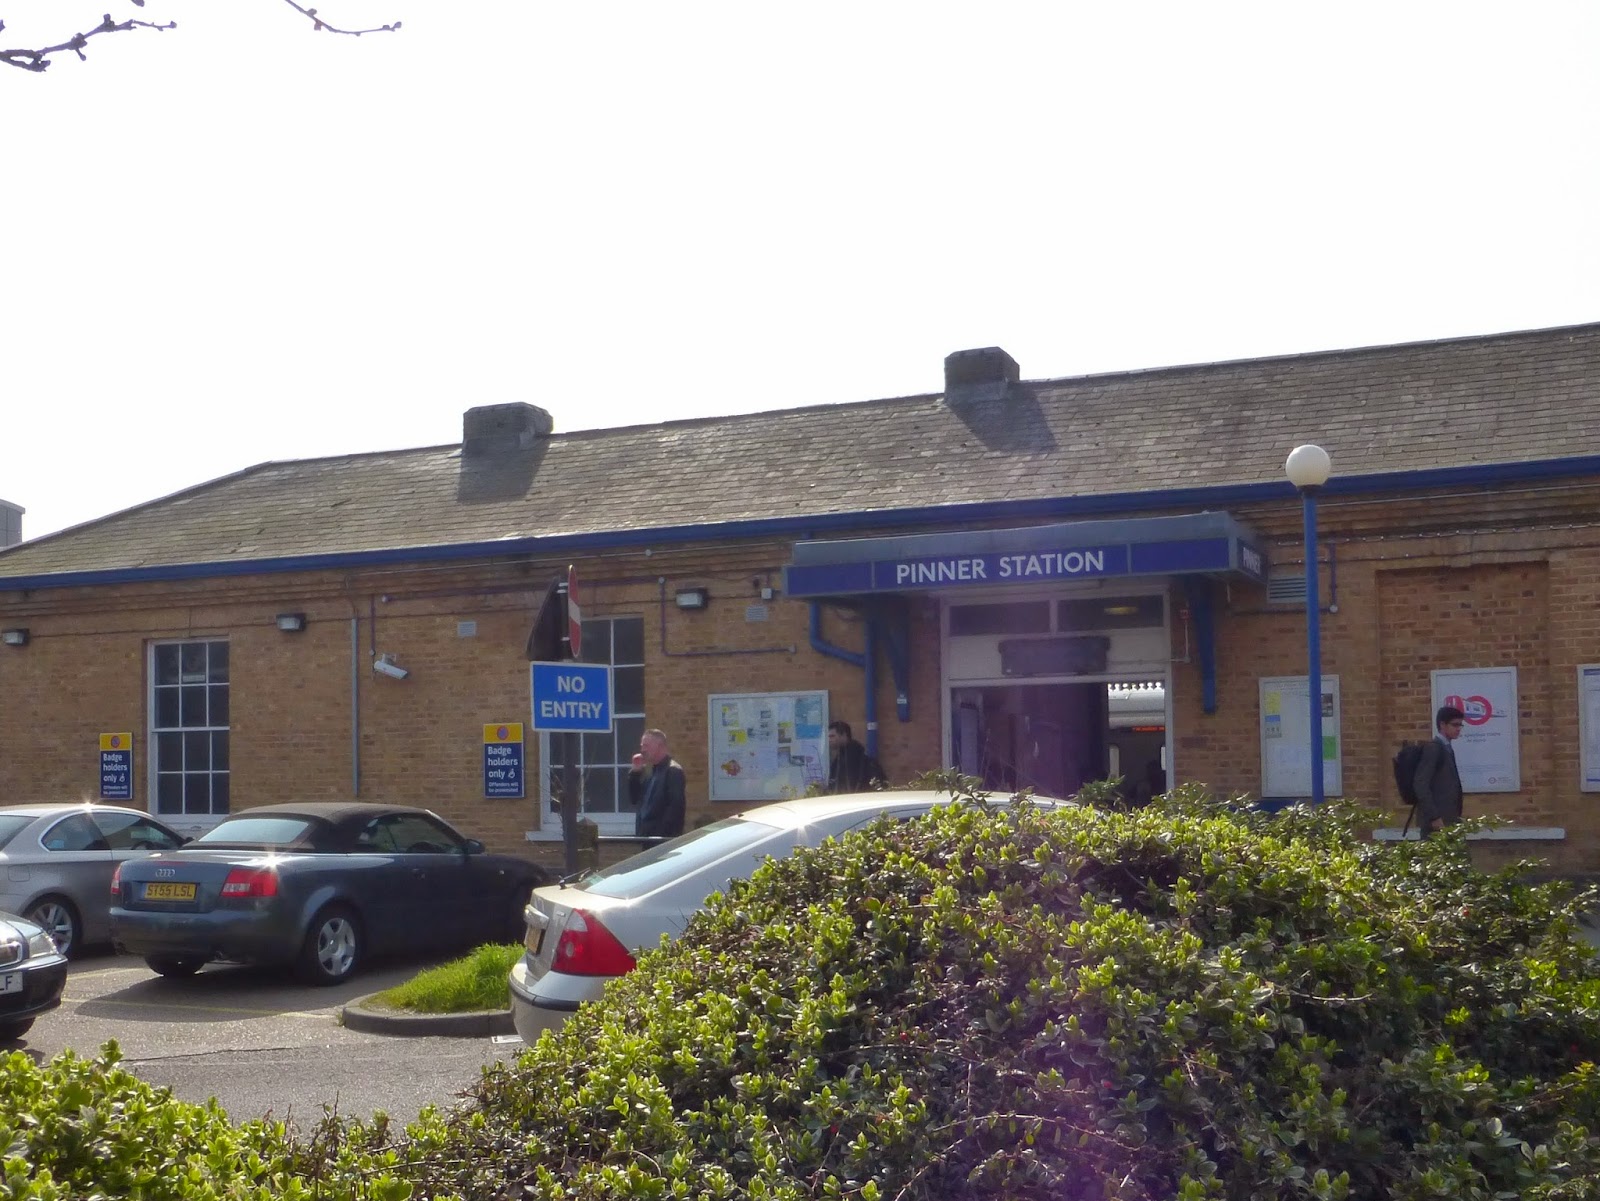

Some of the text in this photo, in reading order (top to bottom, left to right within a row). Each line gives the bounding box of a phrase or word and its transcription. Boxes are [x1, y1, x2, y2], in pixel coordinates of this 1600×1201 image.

[896, 550, 1104, 585] PINNER STATION
[557, 675, 586, 694] NO
[541, 700, 604, 719] ENTRY
[487, 746, 513, 757] Badge
[102, 753, 123, 763] Badge
[487, 757, 519, 766] holders
[102, 763, 128, 771] holders
[103, 773, 118, 783] only
[488, 769, 506, 780] only
[146, 884, 193, 897] ST55 LSL
